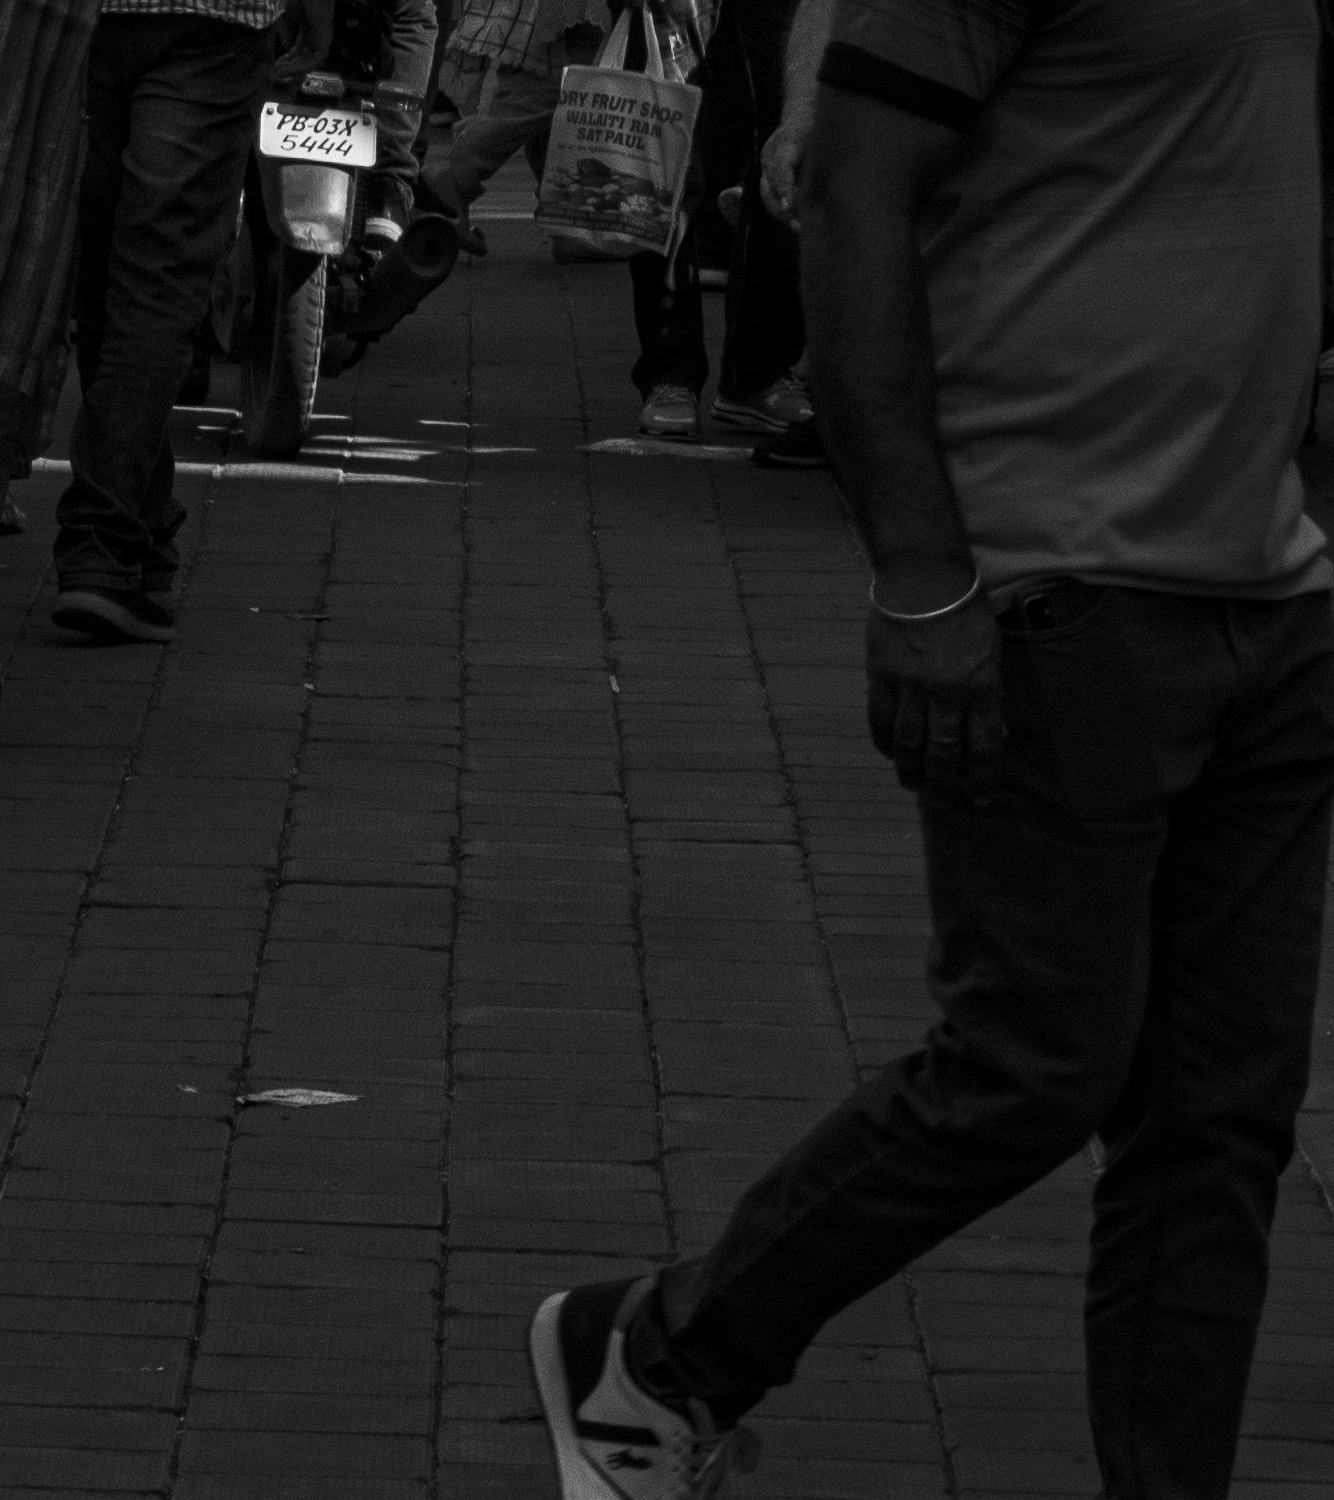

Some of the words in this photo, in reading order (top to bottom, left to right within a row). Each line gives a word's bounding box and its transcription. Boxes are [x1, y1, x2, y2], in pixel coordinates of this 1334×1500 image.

[566, 109, 626, 130] WALAITI
[591, 93, 638, 117] FRUIT
[640, 101, 684, 125] SHOP
[280, 133, 354, 157] 5444
[577, 127, 603, 142] SAT
[604, 131, 646, 151] PAUL
